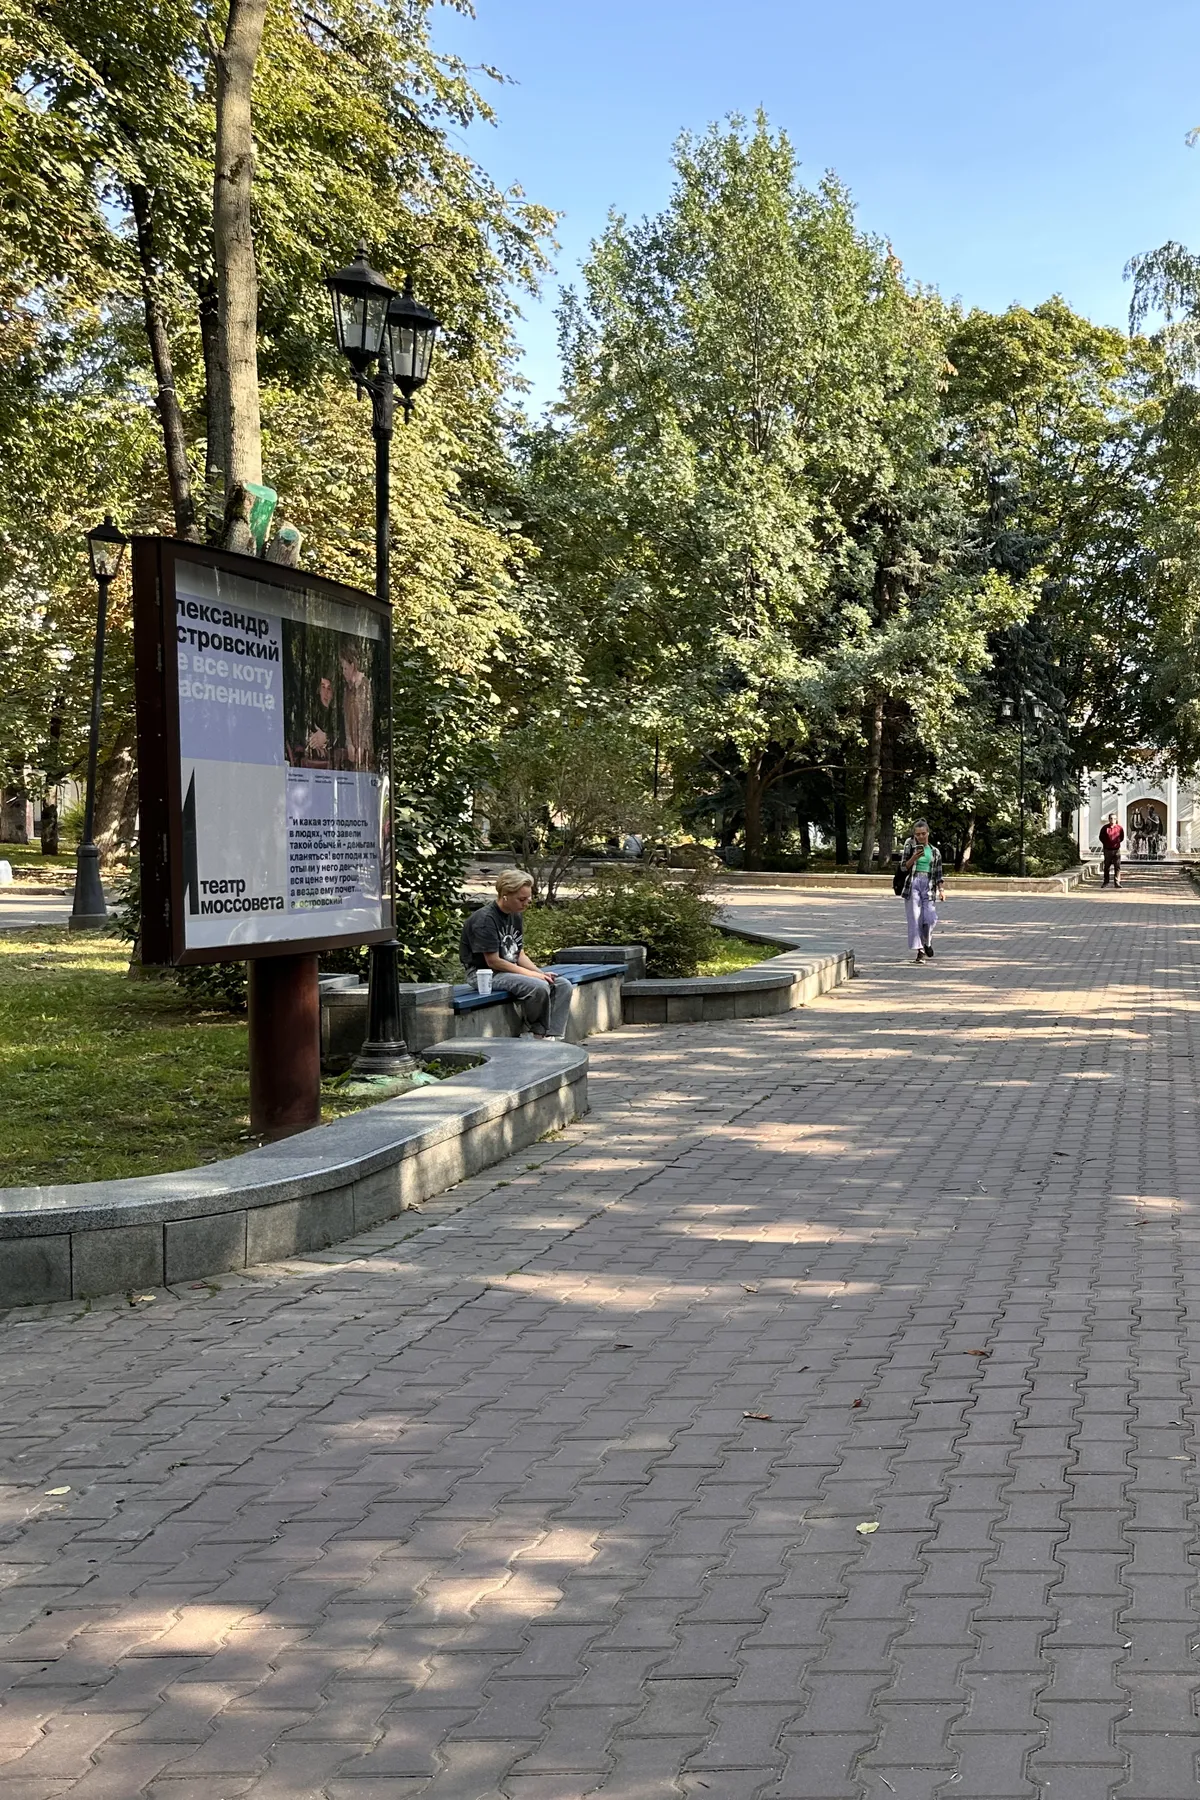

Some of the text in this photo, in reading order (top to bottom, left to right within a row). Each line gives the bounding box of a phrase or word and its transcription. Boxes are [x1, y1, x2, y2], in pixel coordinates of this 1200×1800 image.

[176, 598, 269, 639] лександр
[177, 625, 280, 662] стровский
[178, 652, 274, 690] е все коту
[180, 680, 275, 712] асленица
[299, 819, 321, 827] какая
[322, 819, 335, 827] это
[289, 830, 294, 838] в
[295, 830, 322, 840] людях,
[323, 830, 336, 838] что
[289, 840, 313, 849] такой
[347, 841, 376, 850] деньгам
[289, 851, 331, 861] кланяться!
[332, 852, 344, 860] вот
[316, 864, 321, 874] у
[321, 864, 339, 872] него
[290, 876, 304, 885] вся
[324, 875, 339, 884] ему
[200, 878, 246, 897] театр
[290, 889, 296, 897] а
[320, 887, 334, 896] ему
[200, 895, 284, 915] моссовета
